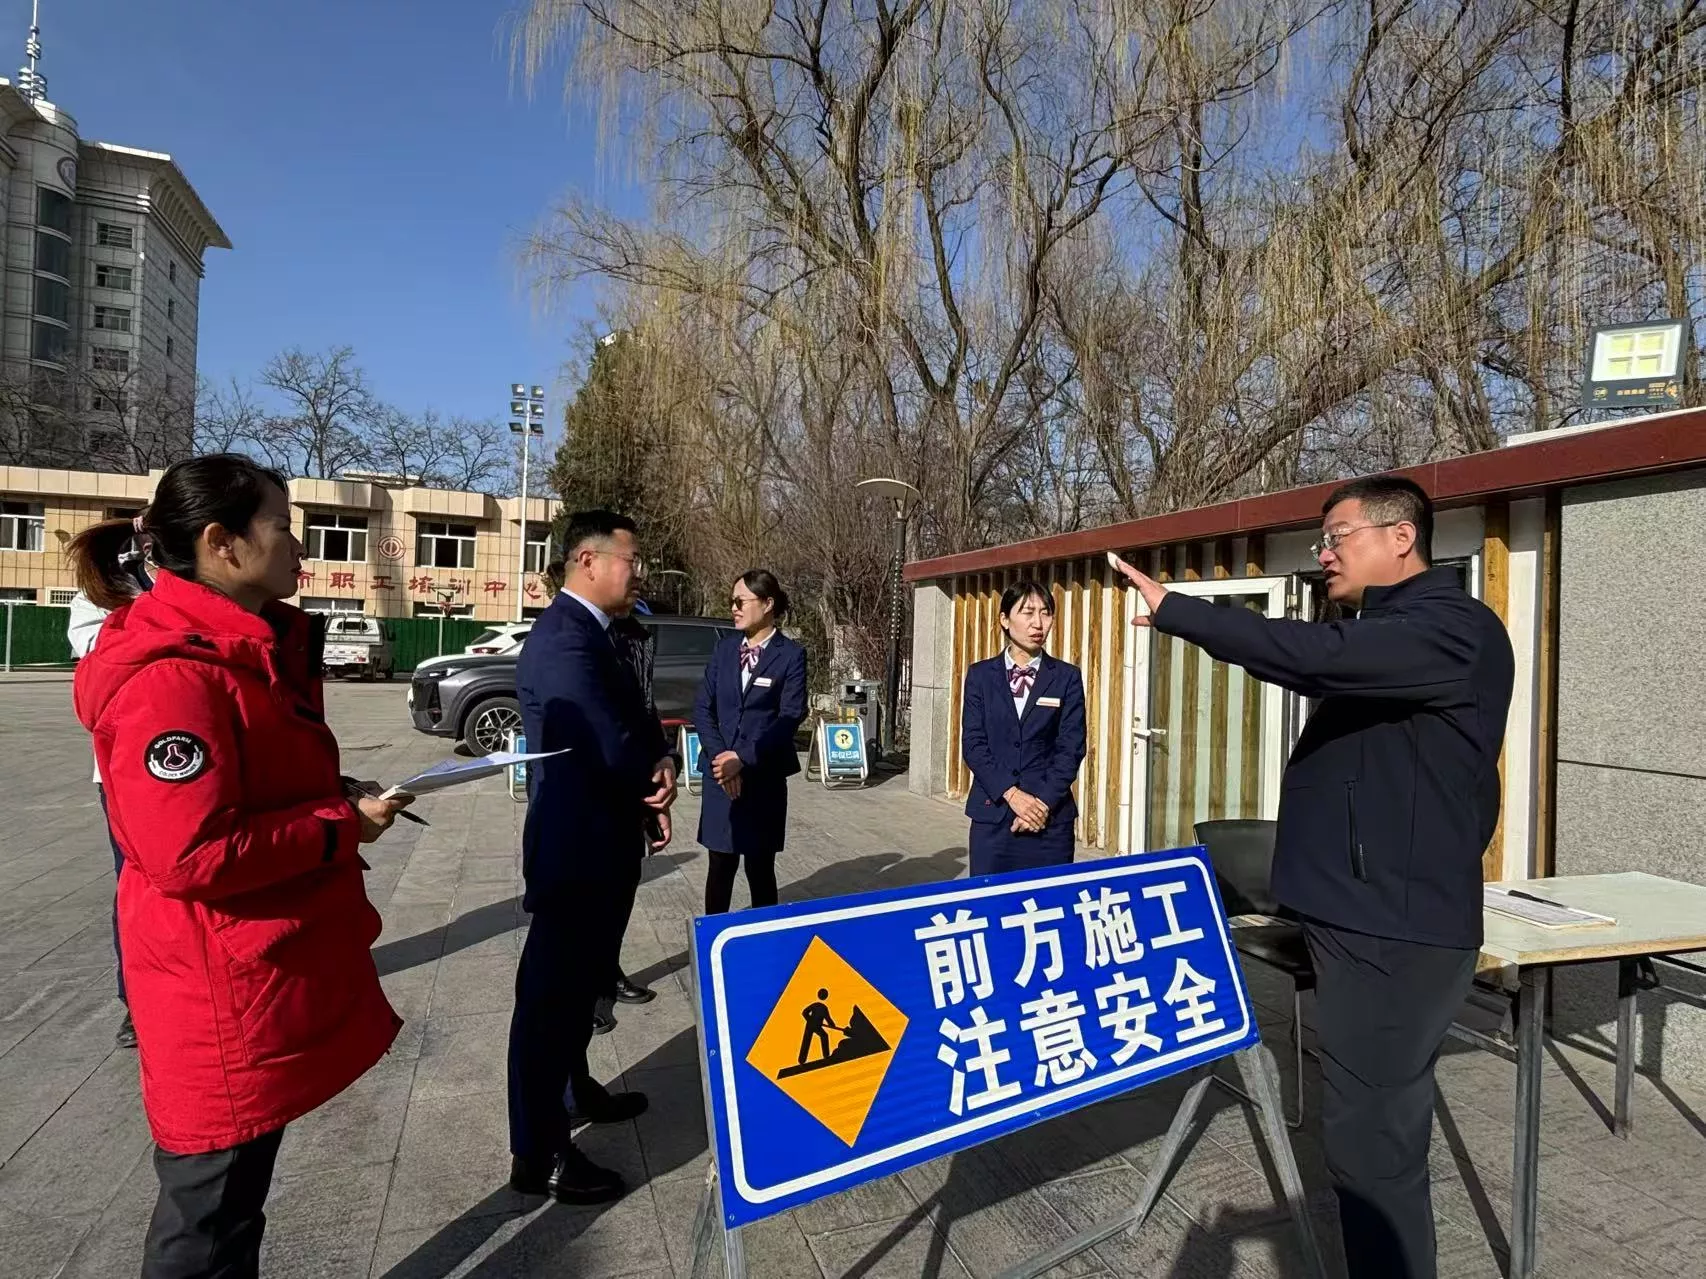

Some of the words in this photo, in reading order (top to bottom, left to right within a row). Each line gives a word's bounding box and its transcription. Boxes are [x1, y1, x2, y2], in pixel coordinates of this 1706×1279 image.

[915, 880, 1204, 1009] 前方施工
[937, 958, 1226, 1116] 注意安全
